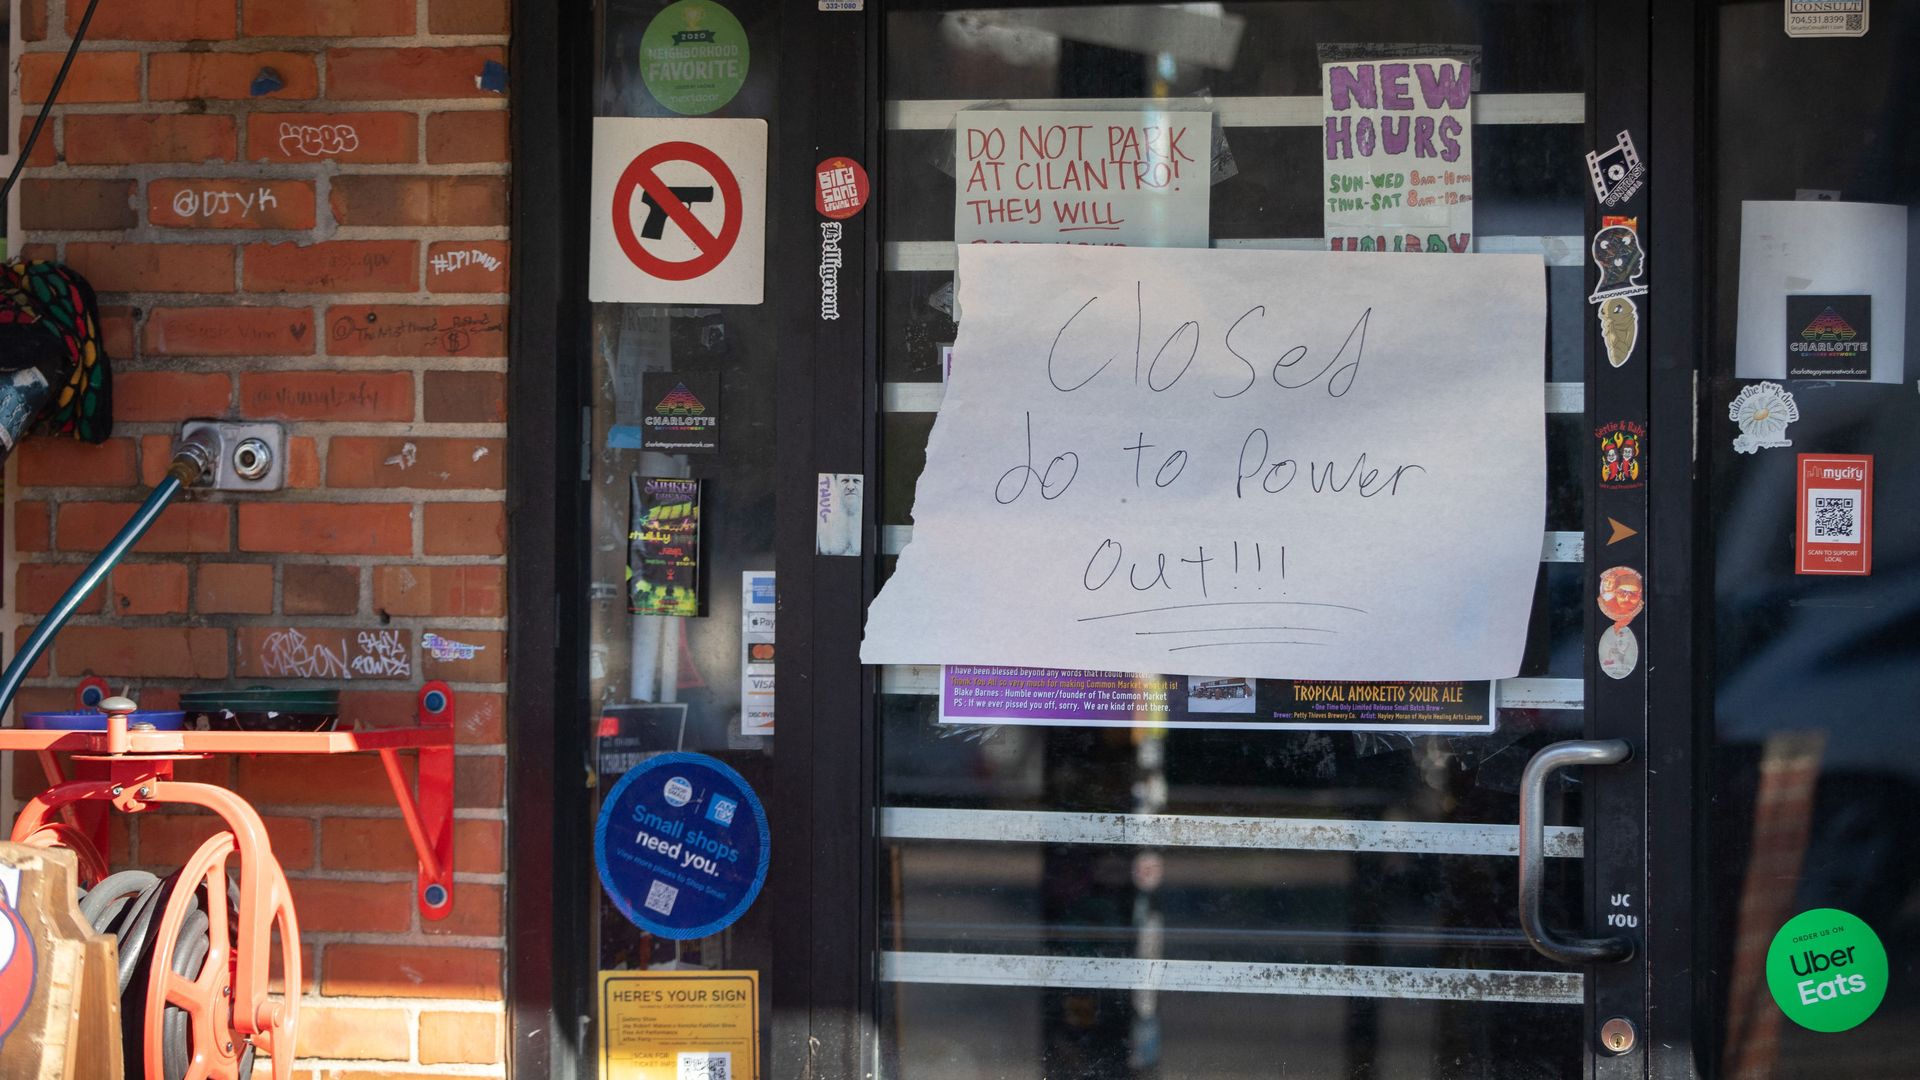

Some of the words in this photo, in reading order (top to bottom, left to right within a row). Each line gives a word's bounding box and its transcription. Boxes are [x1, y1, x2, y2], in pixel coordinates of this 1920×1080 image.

[1794, 2, 1860, 11] CONSULT
[1791, 16, 1844, 24] 704.531.8399
[680, 33, 706, 41] 2020
[648, 44, 738, 60] NEIGHBORHOOD
[649, 60, 738, 82] FAVORITE
[1329, 63, 1471, 111] NEW
[967, 127, 1005, 161] DO
[1019, 125, 1093, 161] NOT
[1108, 125, 1195, 162] PARK
[1326, 116, 1463, 163] HOURS
[966, 161, 1005, 192] AT
[1015, 158, 1180, 192] CILANTRO!
[1605, 162, 1646, 207] CONTRAST
[1621, 179, 1643, 203] MEDIA
[966, 198, 1042, 225] THEY
[1053, 200, 1125, 225] WILL
[1790, 342, 1868, 352] CHARLOTTE
[1730, 395, 1746, 420] calm
[1743, 385, 1760, 399] the
[1781, 392, 1798, 421] down
[645, 416, 716, 426] CHARLOTTE
[994, 411, 1080, 505] do
[1123, 432, 1188, 489] to
[1237, 427, 1427, 499] Power
[1823, 466, 1863, 481] mycity
[1083, 538, 1288, 599] Out!!!
[760, 617, 775, 629] Pay
[954, 667, 972, 676] have
[973, 667, 990, 676] been
[992, 667, 1018, 677] blessed
[1020, 668, 1045, 679] beyond
[1046, 670, 1059, 679] any
[1061, 669, 1081, 678] words
[1084, 670, 1098, 678] that
[752, 680, 775, 689] VISA
[1027, 679, 1045, 688] much
[1047, 680, 1058, 688] for
[1060, 679, 1085, 690] making
[1087, 680, 1116, 689] Common
[1118, 680, 1141, 689] Market
[954, 687, 973, 697] Blake
[975, 688, 999, 698] Barnes
[1005, 689, 1031, 699] Humble
[1033, 689, 1087, 700] owner/founder
[1088, 690, 1096, 700] of
[1098, 691, 1110, 700] The
[1112, 691, 1141, 701] Common
[1143, 692, 1167, 701] Market
[1294, 685, 1344, 702] TROPICAL
[1348, 685, 1405, 702] AMORETTO
[1409, 686, 1439, 702] SOUR
[1442, 687, 1463, 703] ALE
[1005, 699, 1028, 710] pissed
[1029, 702, 1042, 711] you
[1044, 701, 1057, 711] off,
[1059, 703, 1080, 712] sorry.
[1083, 702, 1095, 711] We
[1110, 703, 1125, 712] kind
[1127, 703, 1135, 712] of
[1136, 704, 1148, 712] out
[1150, 703, 1171, 712] there.
[1339, 704, 1351, 712] Only
[1293, 712, 1307, 720] Petty
[1308, 712, 1326, 720] Thieves
[632, 804, 684, 839] Small
[685, 830, 740, 863] shops
[636, 830, 683, 859] need
[680, 851, 720, 877] you.
[1607, 913, 1638, 928] YOU
[1792, 932, 1818, 944] ORDER
[1820, 929, 1830, 938] US
[1832, 926, 1845, 934] ON
[1790, 946, 1856, 976] Uber
[613, 990, 664, 1002] HERE'S
[667, 990, 707, 1002] YOUR
[711, 990, 746, 1002] SIGN
[1797, 973, 1867, 1006] Eats
